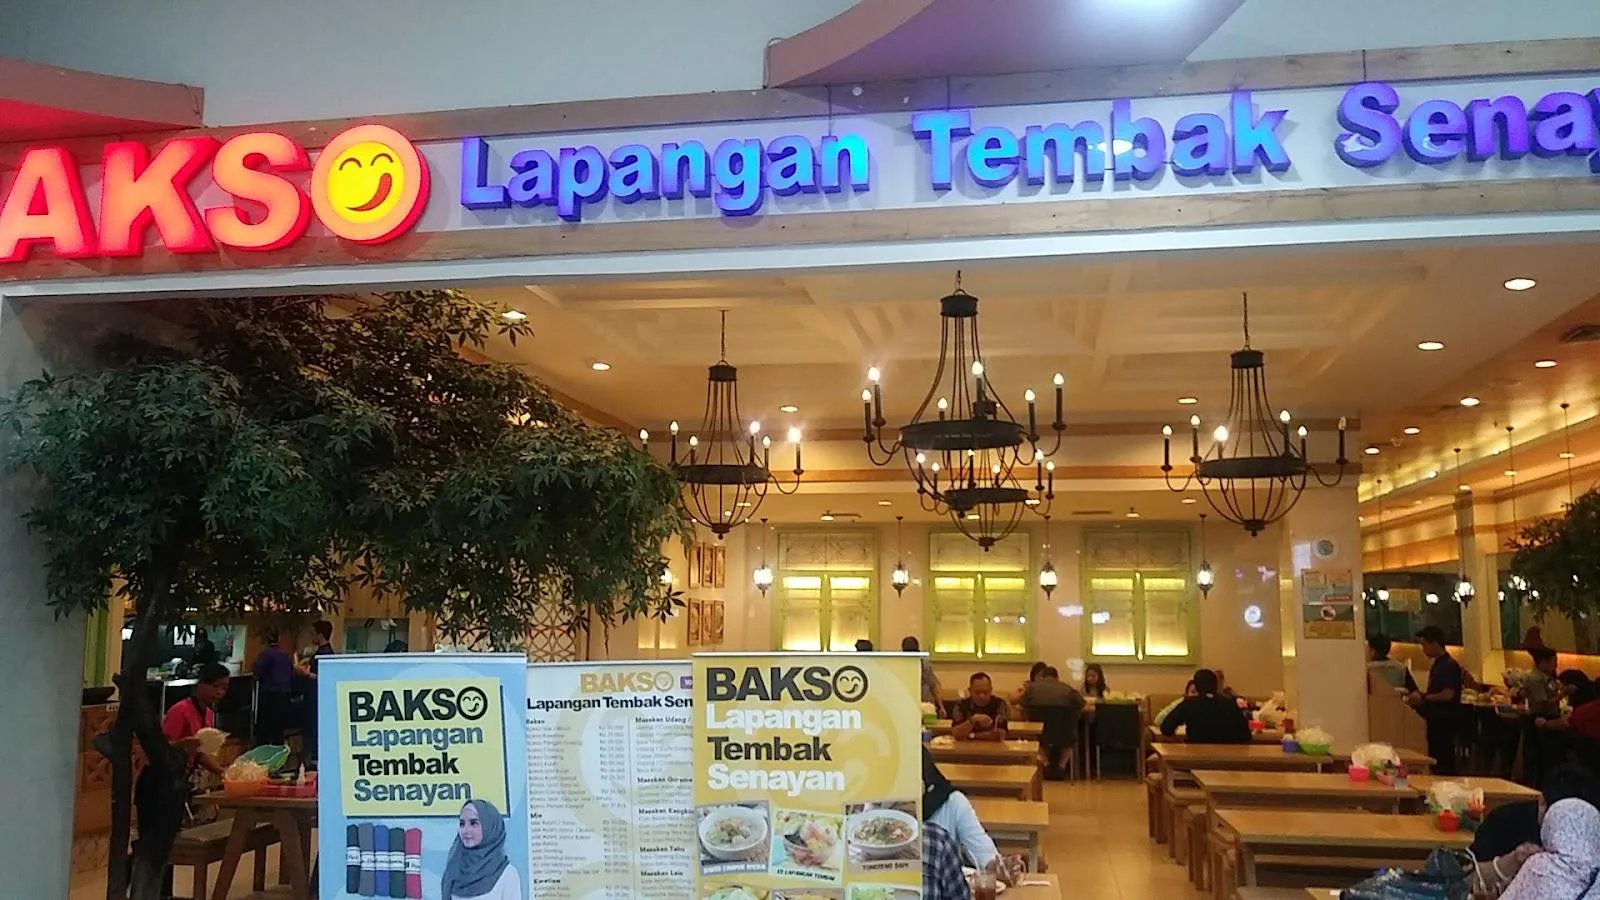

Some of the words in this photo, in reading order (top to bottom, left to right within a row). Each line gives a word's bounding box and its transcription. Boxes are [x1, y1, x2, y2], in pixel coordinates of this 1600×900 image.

[461, 135, 870, 221] Lapangan
[912, 91, 1292, 191] Tembak
[580, 671, 674, 693] BAKSO
[706, 665, 868, 703] BAKSO
[348, 686, 488, 723] BAKSO
[526, 697, 601, 712] Lapangan
[602, 696, 662, 709] Tembak
[706, 704, 861, 735] Lapangan
[350, 724, 483, 752] Lapangan
[708, 737, 832, 761] Tembak
[352, 753, 459, 776] Tembak
[354, 779, 471, 806] Senayan
[708, 764, 845, 797] Senayan
